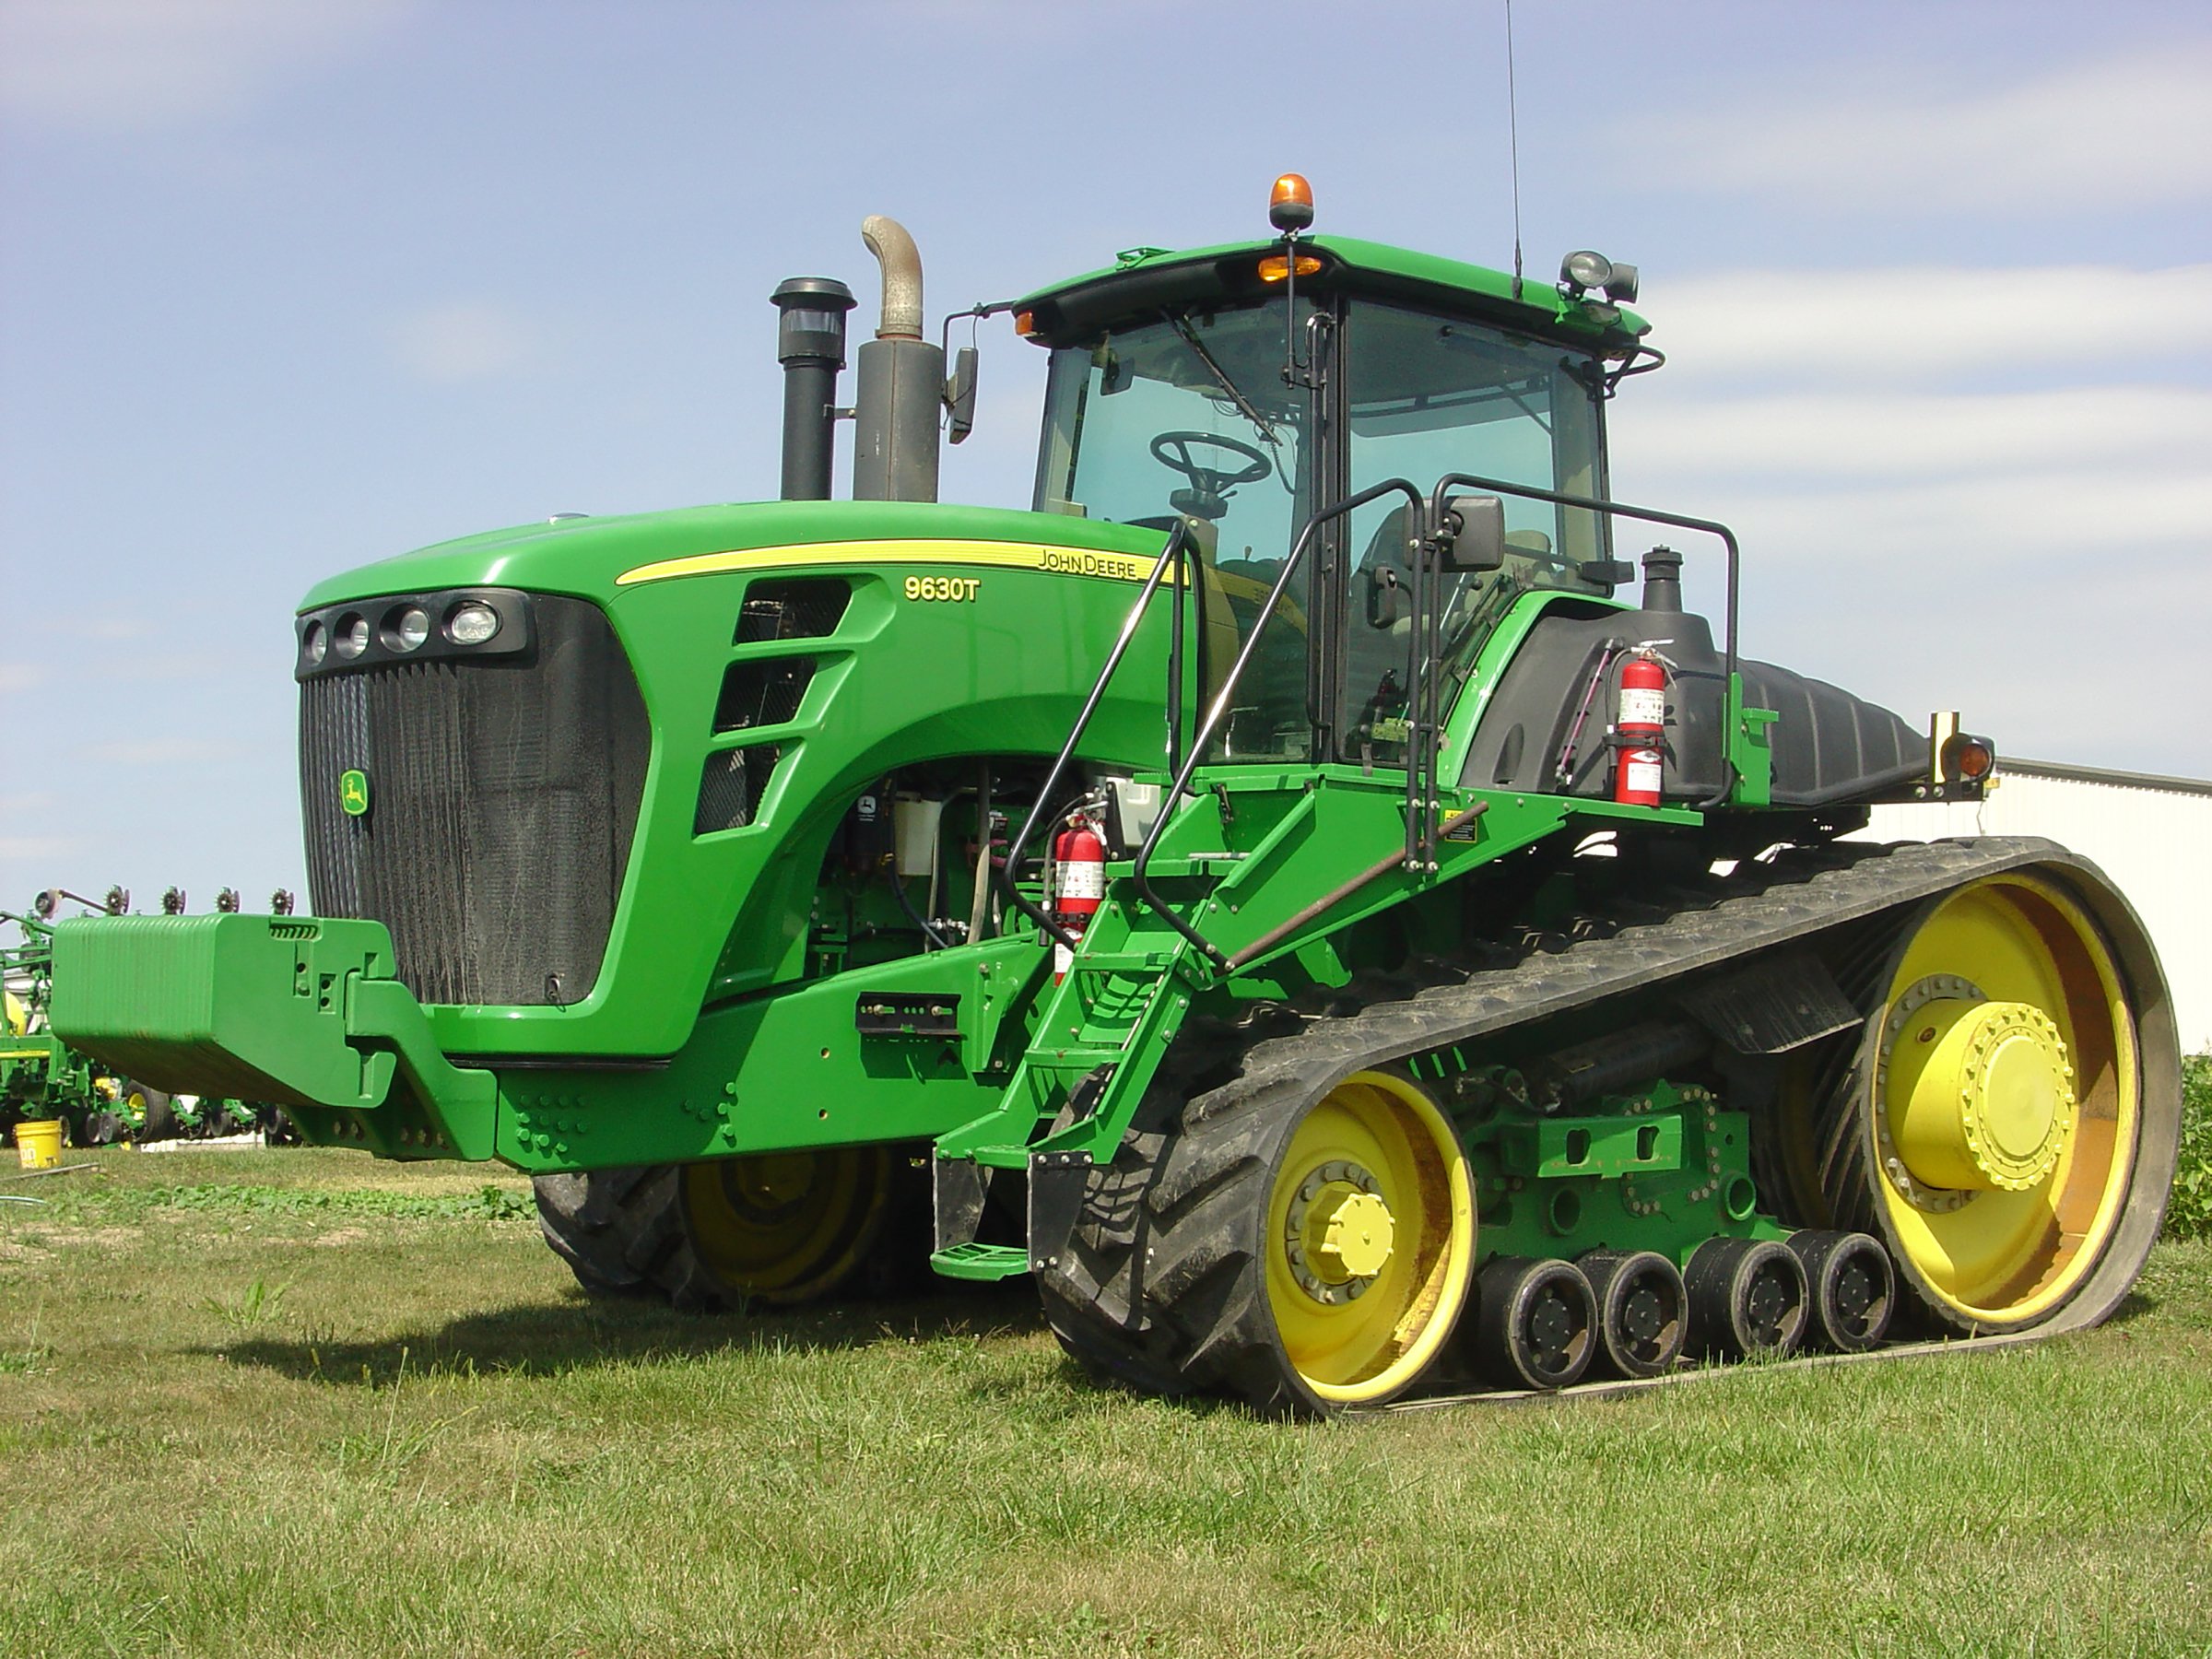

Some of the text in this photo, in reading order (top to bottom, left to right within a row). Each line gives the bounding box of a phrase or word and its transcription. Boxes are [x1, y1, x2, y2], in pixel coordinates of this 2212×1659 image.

[1039, 549, 1136, 577] JOHN DEERE
[905, 575, 981, 601] 9630T
